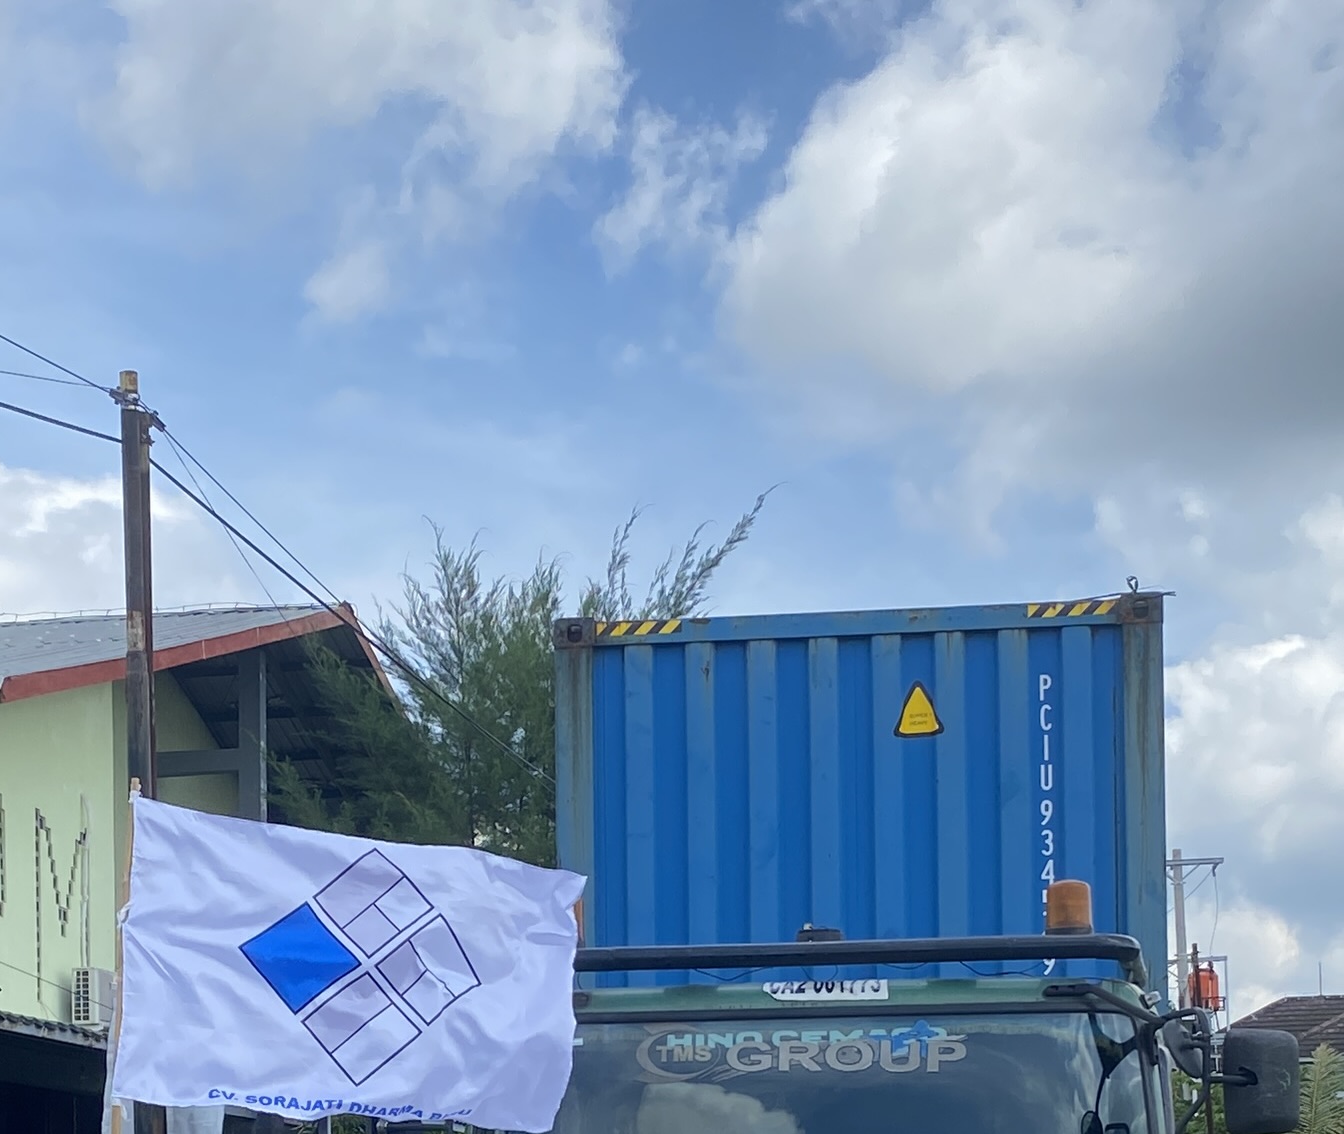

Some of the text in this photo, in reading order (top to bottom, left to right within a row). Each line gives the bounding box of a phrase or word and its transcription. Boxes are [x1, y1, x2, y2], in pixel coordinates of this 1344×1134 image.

[1039, 673, 1054, 791] PCIU
[655, 1039, 968, 1074] TMS GROUP
[207, 1088, 238, 1101] CV.
[245, 1094, 344, 1112] SORAJATI
